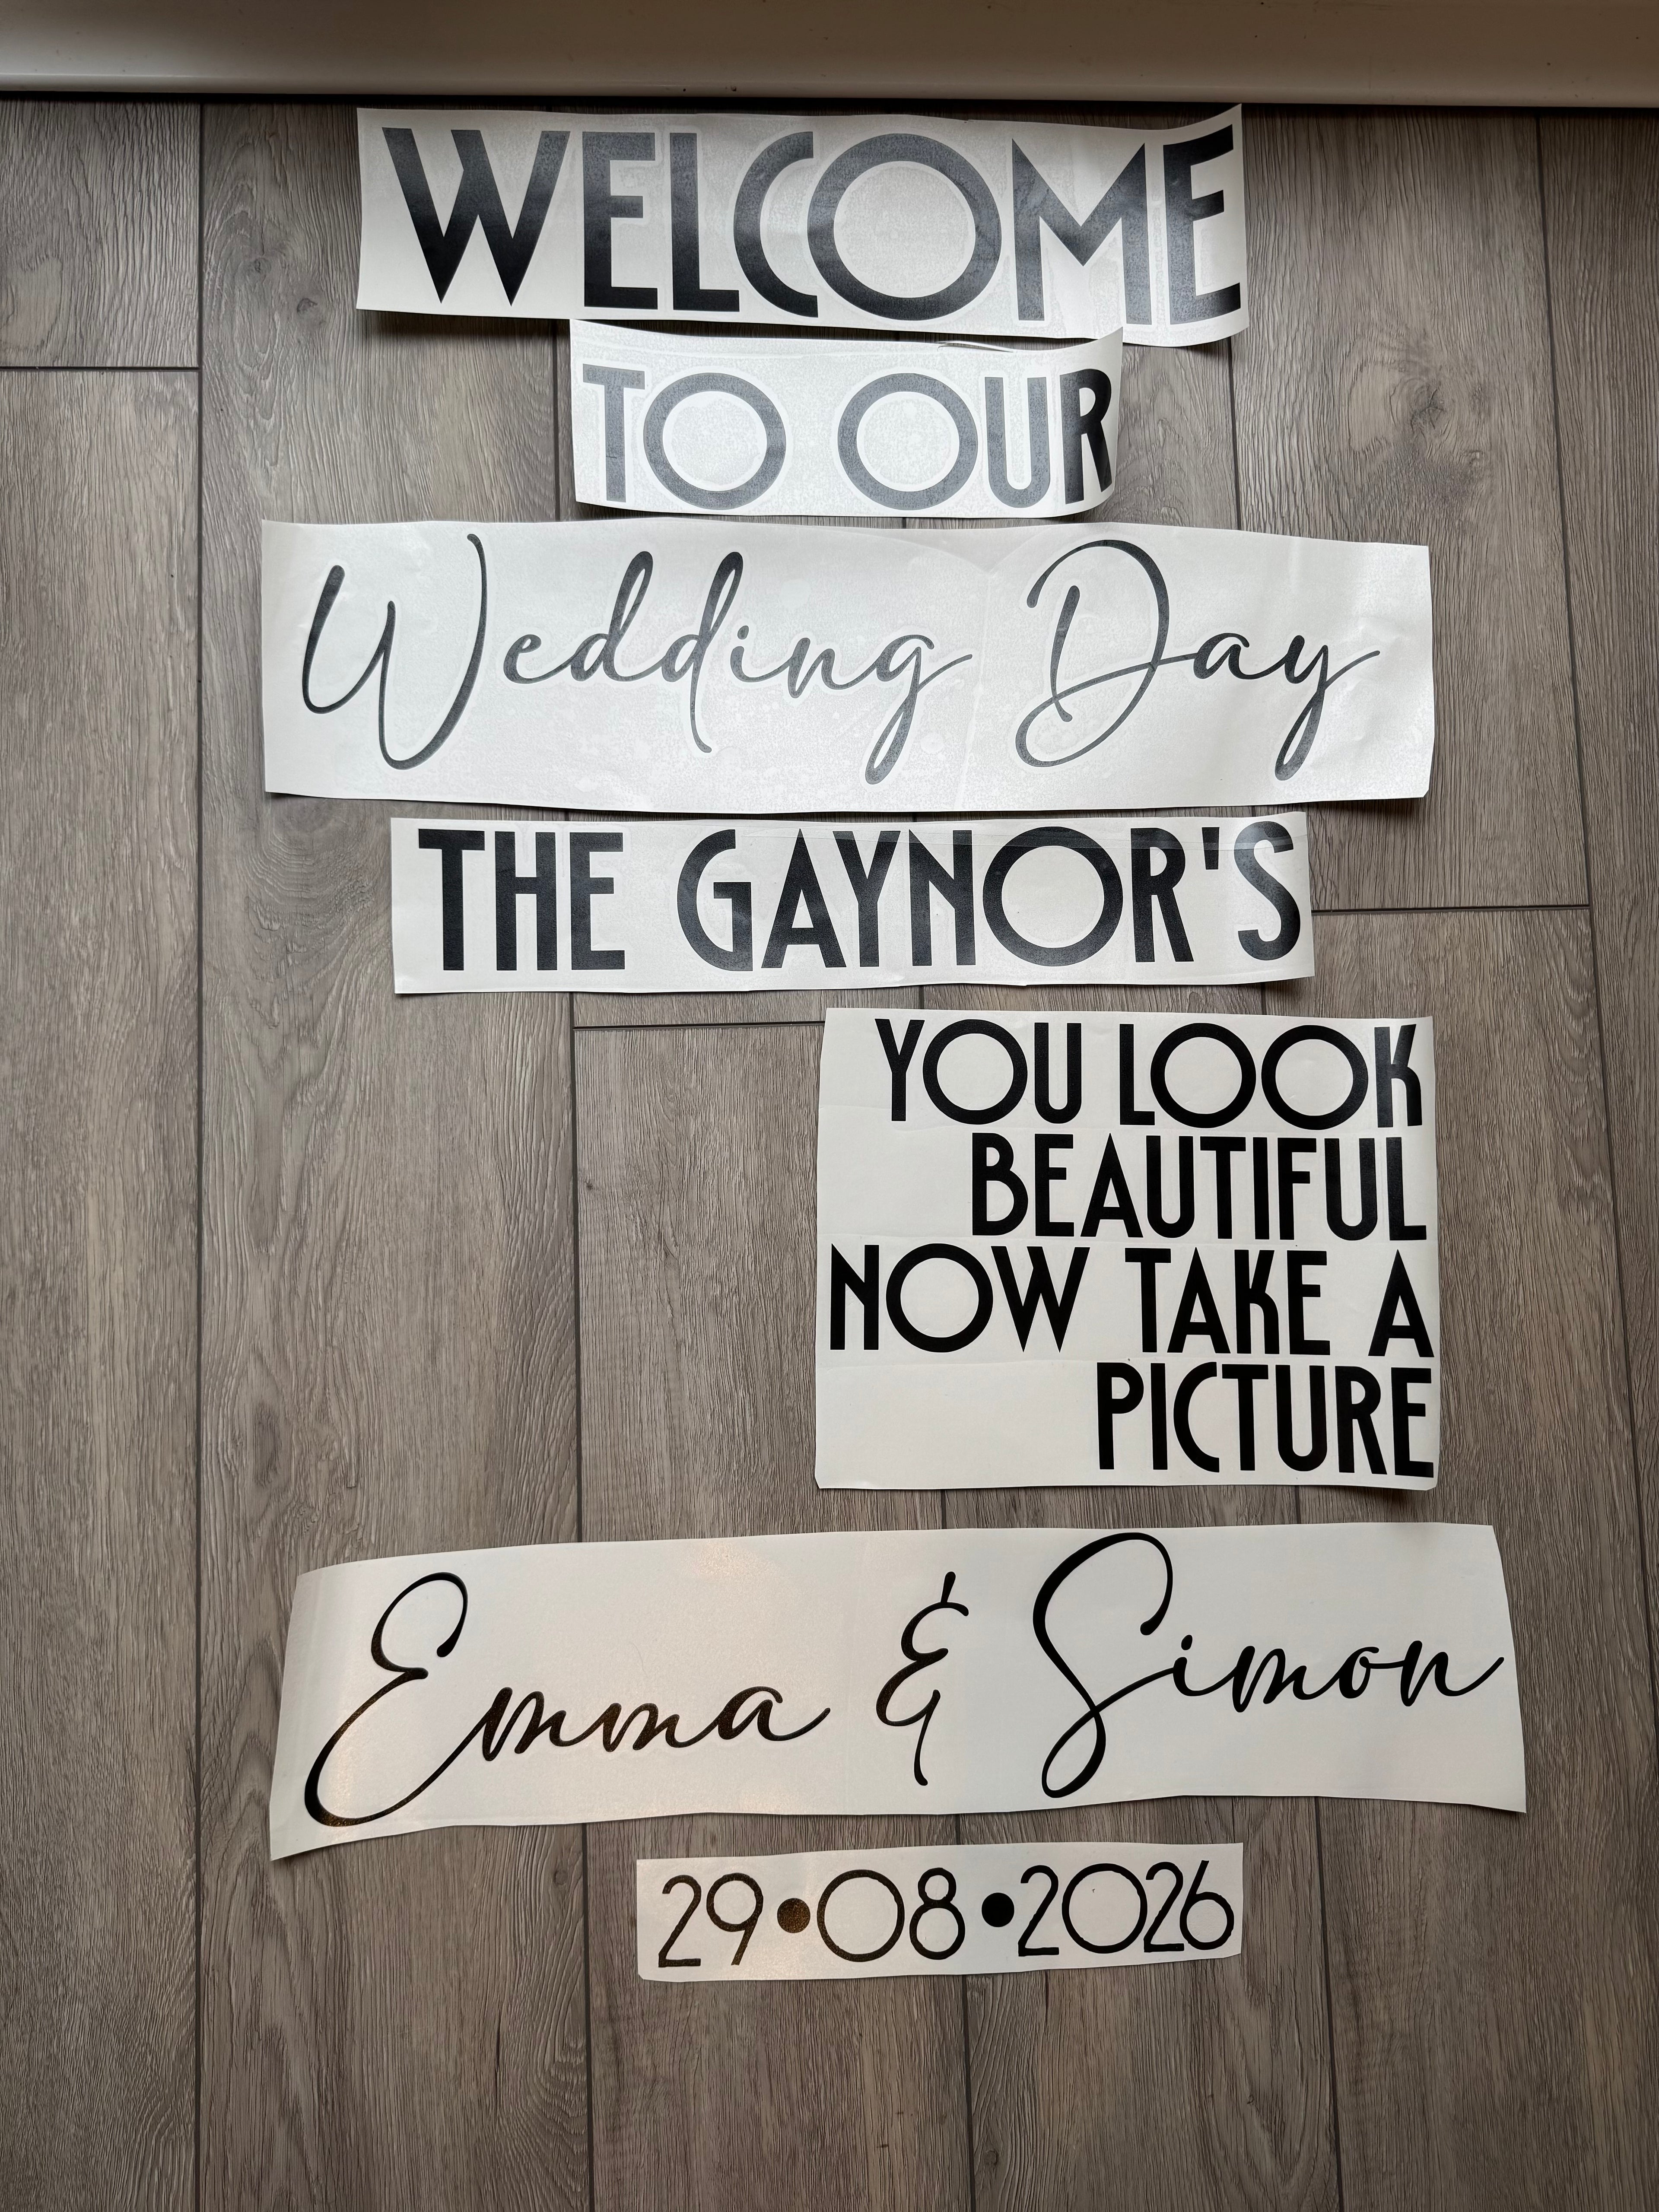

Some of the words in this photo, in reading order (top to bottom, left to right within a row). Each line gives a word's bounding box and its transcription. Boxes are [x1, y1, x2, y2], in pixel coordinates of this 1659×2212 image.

[383, 125, 1243, 325] WELCOME
[583, 364, 787, 510] TO
[838, 368, 1112, 510] OUR
[302, 534, 974, 785] Wedding
[1014, 540, 1381, 781] Day
[417, 828, 625, 972] THE
[677, 821, 1301, 972] GAYNOR'S
[875, 1018, 1082, 1124] YOU
[1119, 1022, 1423, 1130] LOOK
[972, 1132, 1427, 1241] BEAUTIFUL
[831, 1243, 1090, 1353] NOW
[1125, 1247, 1330, 1355] TAKE
[1368, 1249, 1435, 1357] A
[1096, 1361, 1434, 1478] PICTURE
[303, 1571, 832, 1827] Emma
[875, 1571, 969, 1787] &
[1032, 1531, 1505, 1799] Simon
